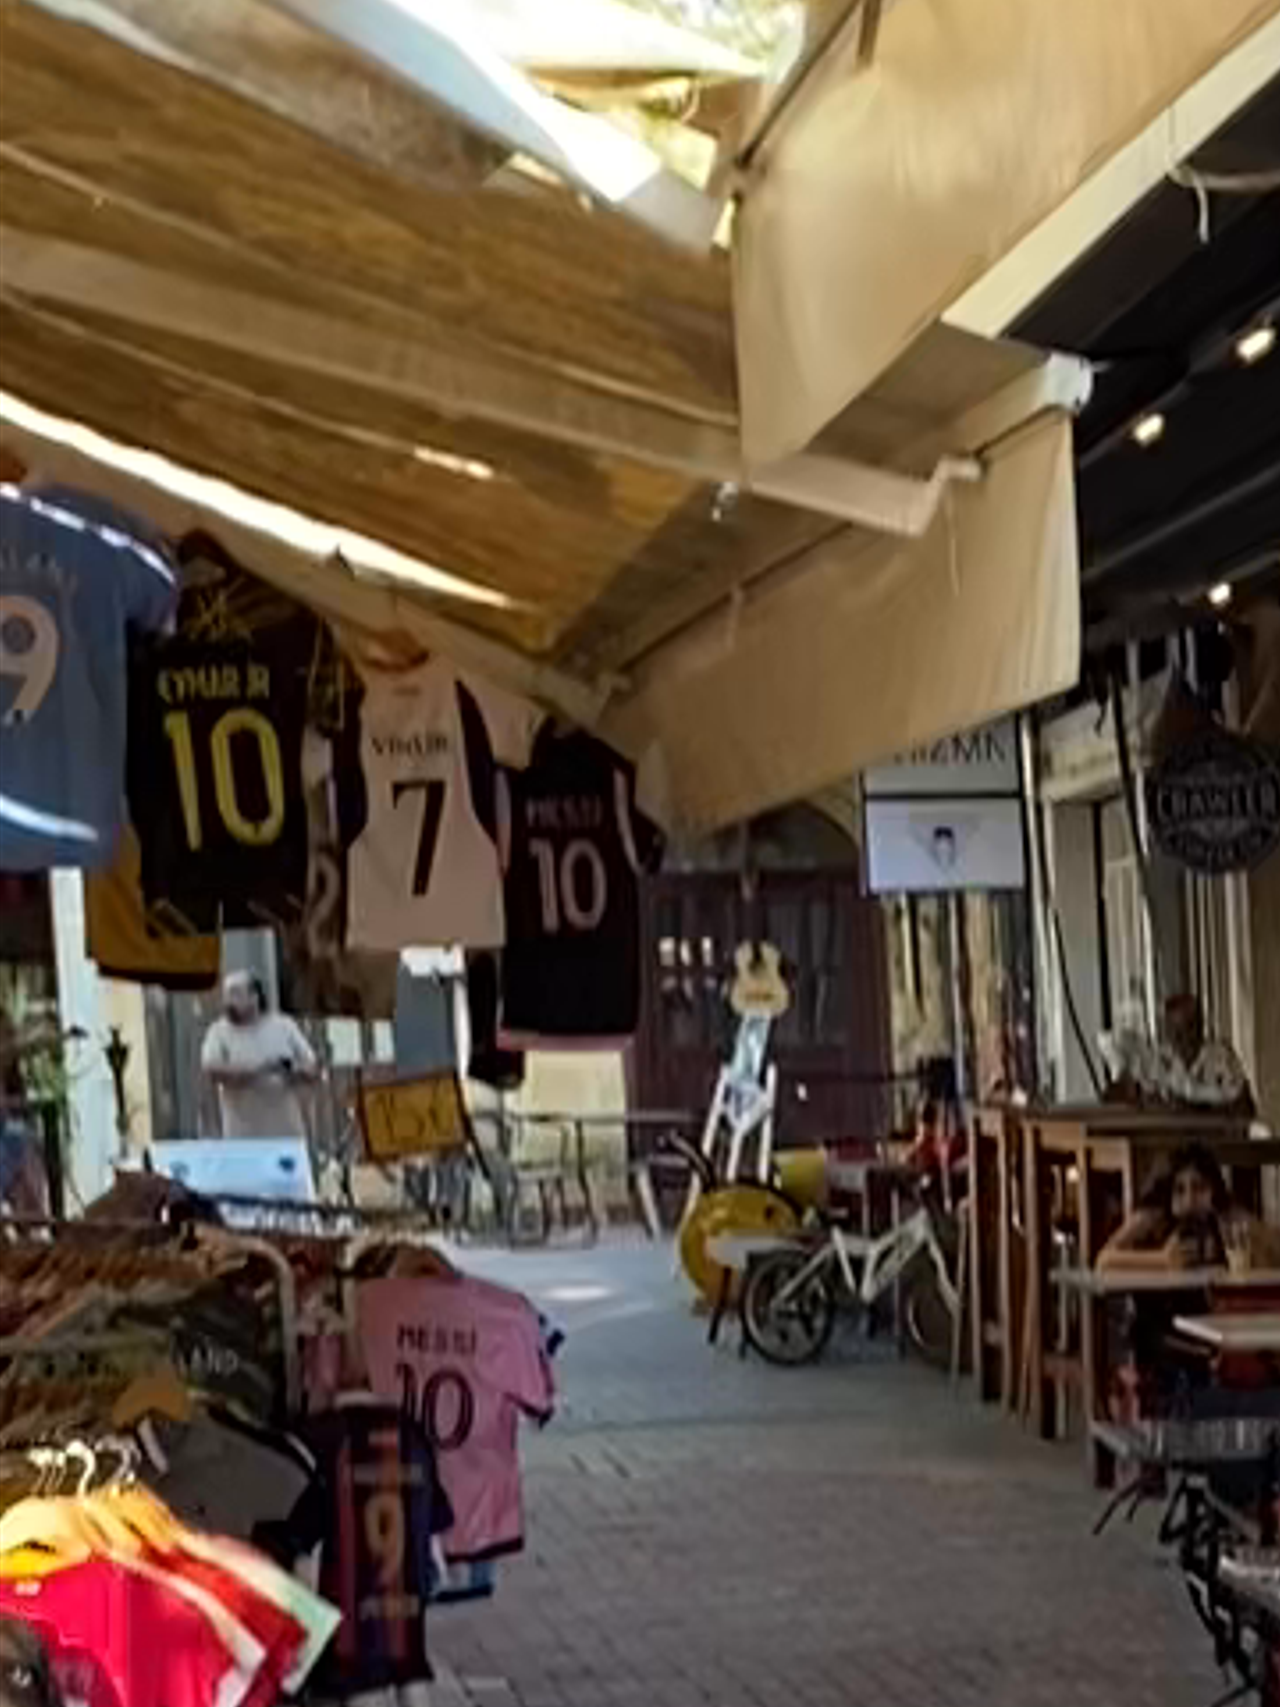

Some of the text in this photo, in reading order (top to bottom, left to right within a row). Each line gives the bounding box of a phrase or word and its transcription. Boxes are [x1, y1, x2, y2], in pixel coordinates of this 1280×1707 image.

[162, 707, 284, 850] 10
[392, 780, 445, 897] 7
[530, 839, 608, 933] 10
[396, 1362, 474, 1451] 10
